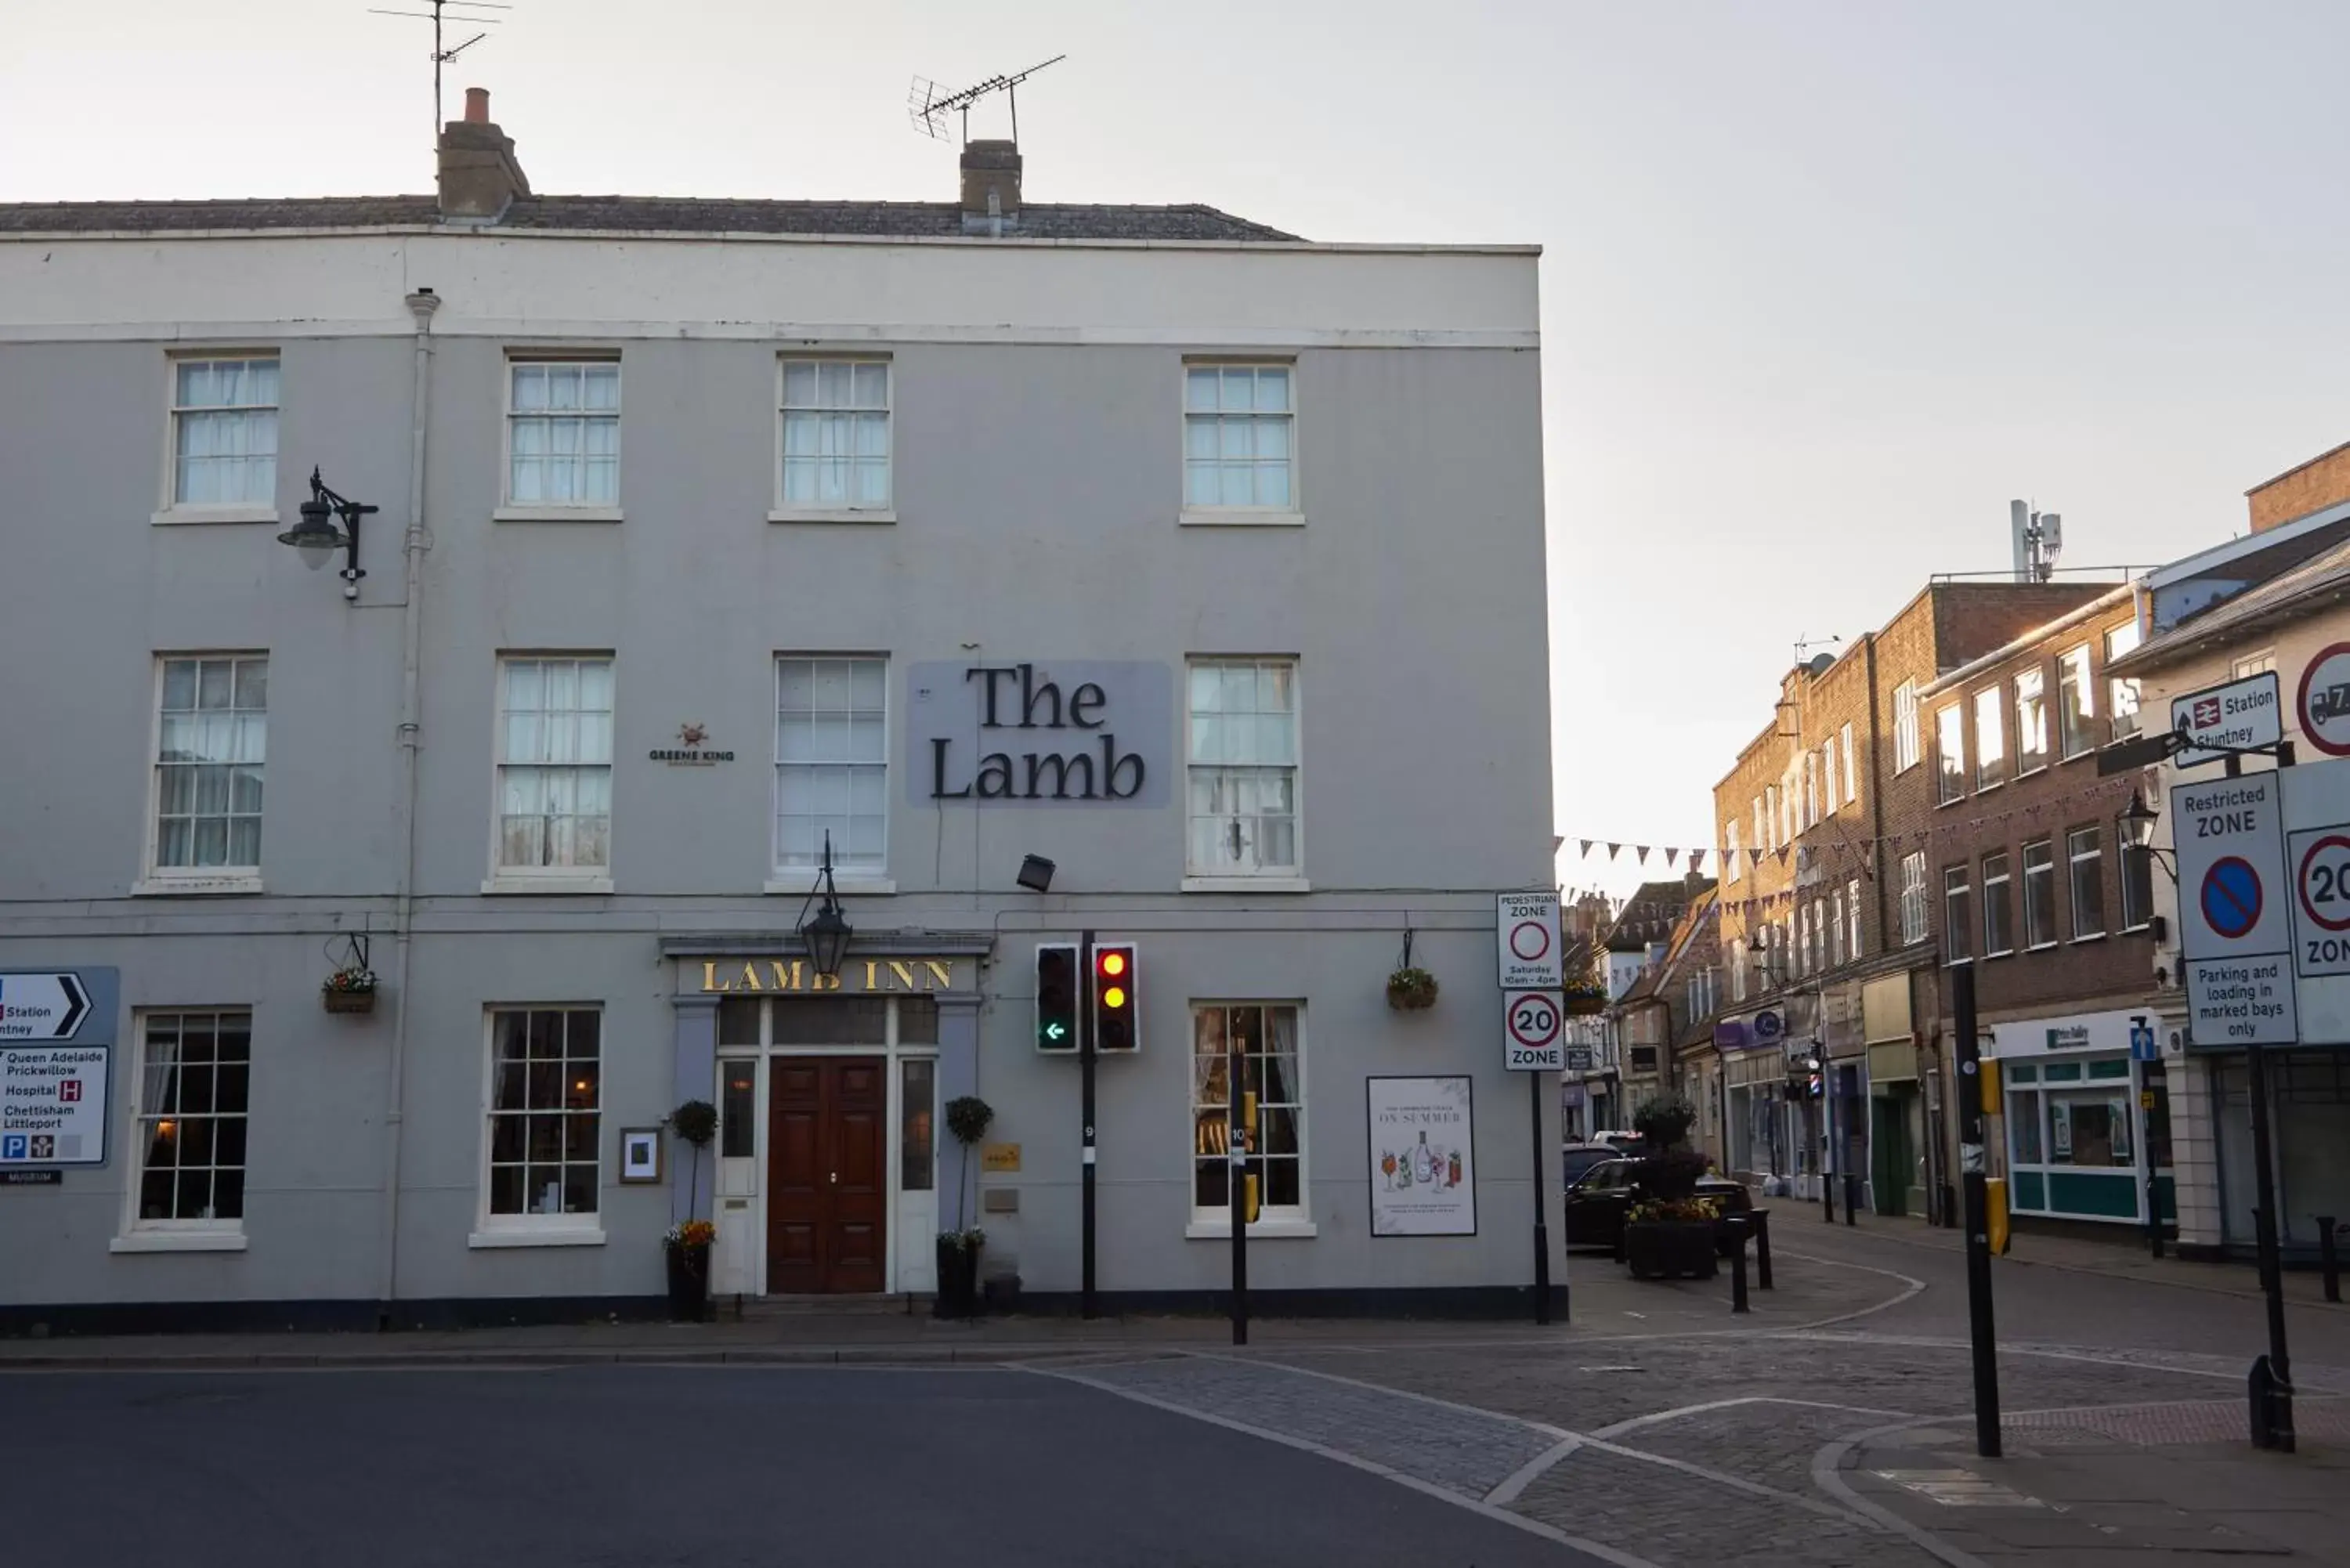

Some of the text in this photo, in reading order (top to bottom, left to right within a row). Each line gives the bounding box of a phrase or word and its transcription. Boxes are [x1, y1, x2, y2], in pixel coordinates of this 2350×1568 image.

[964, 663, 1106, 728] The
[2225, 690, 2273, 715] Station
[649, 750, 735, 761] GREENE KING
[930, 734, 1144, 798] Lamb
[2185, 784, 2265, 814] Restricted
[2196, 810, 2256, 838] ZONE
[1502, 895, 1556, 904] PEDESTRIAN
[1510, 905, 1547, 917] ZONE
[862, 959, 953, 992] INN
[1509, 964, 1551, 974] Saturday
[2199, 963, 2277, 984] Parking and
[1536, 975, 1557, 985] 4pm
[2207, 982, 2272, 1001] loading in
[6, 1006, 51, 1017] Station
[2200, 1002, 2284, 1020] marked bays
[1517, 1010, 1553, 1031] 20
[2228, 1021, 2256, 1039] only
[7, 1051, 103, 1064] Queen Adelaide
[1513, 1050, 1559, 1064] ZONE
[7, 1065, 77, 1076] Prickwillow
[5, 1084, 57, 1097] Hospital
[4, 1105, 74, 1116] Chettisham
[4, 1118, 63, 1130] Littleport
[1085, 1125, 1093, 1136] 9
[1232, 1128, 1245, 1141] 10
